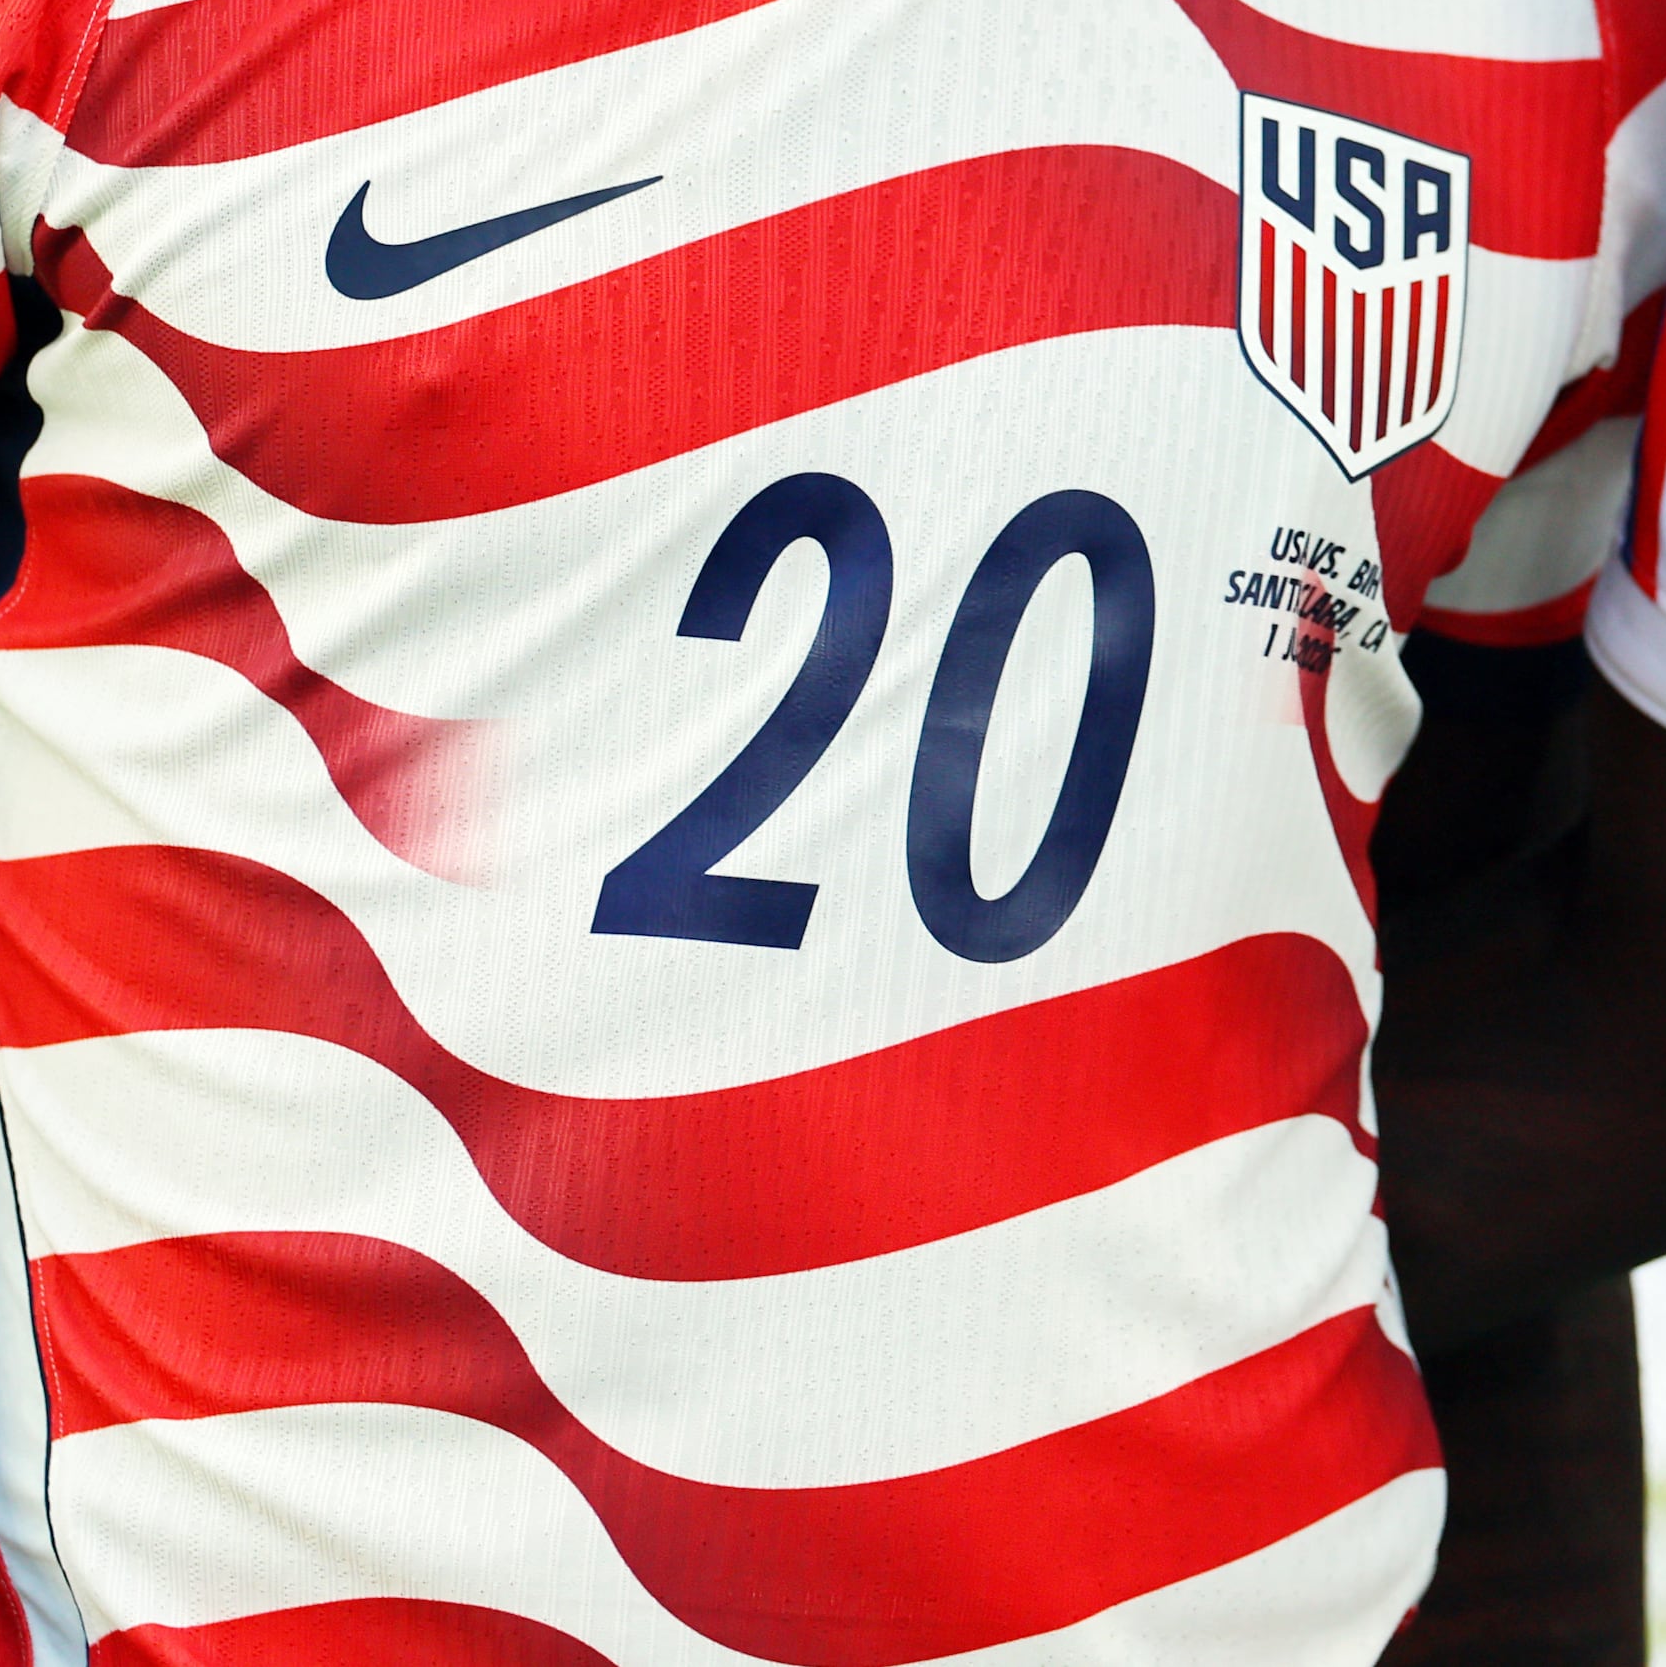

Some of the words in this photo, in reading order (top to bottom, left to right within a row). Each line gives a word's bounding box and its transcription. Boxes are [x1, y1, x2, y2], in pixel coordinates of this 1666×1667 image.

[1261, 117, 1451, 270] USA
[1224, 570, 1303, 614] SANT
[1306, 537, 1346, 580] VS.
[590, 472, 1156, 964] 20
